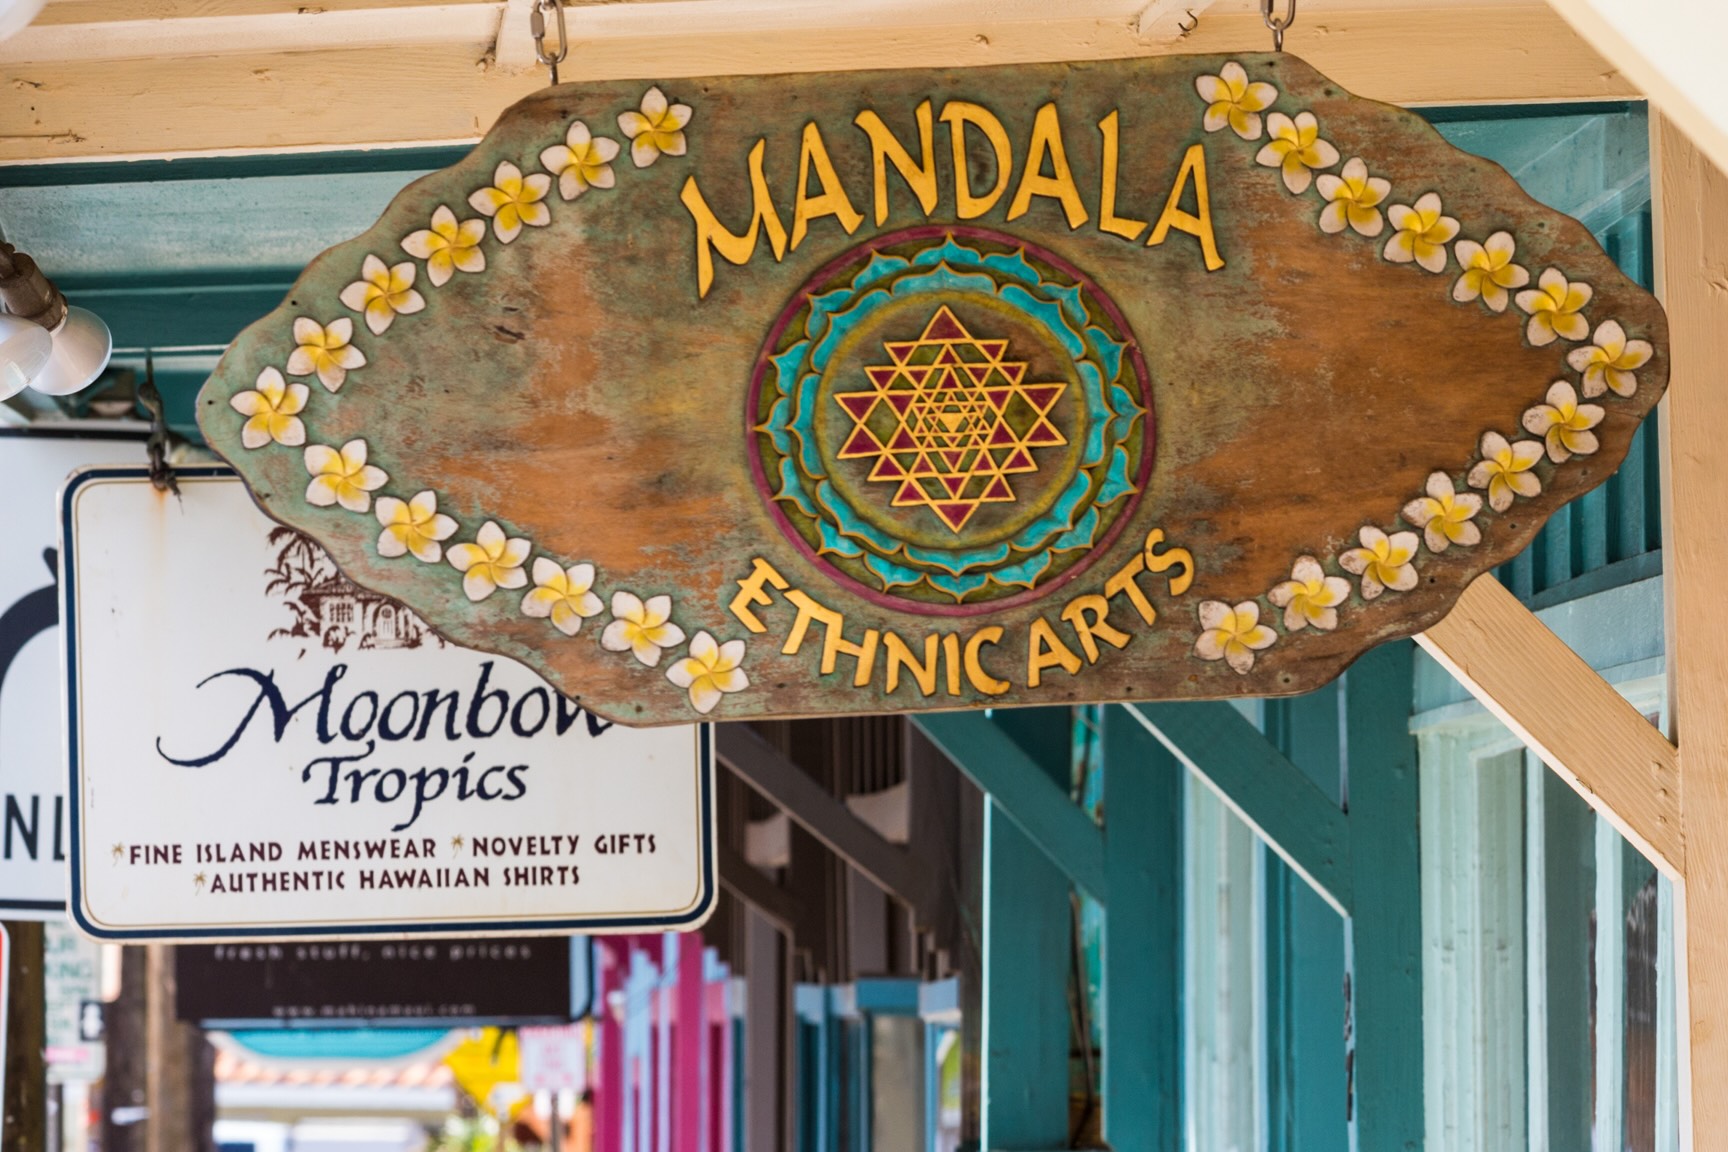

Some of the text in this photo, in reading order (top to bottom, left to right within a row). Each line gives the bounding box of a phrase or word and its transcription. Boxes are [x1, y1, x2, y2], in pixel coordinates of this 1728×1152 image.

[680, 101, 1225, 298] MANDALA
[727, 528, 1195, 697] ETHNIC ARTS
[156, 660, 615, 768] Moonbow
[302, 740, 530, 832] Tropics
[130, 834, 656, 865] FINE ISLAND MENSWEAR NOVELTY GIFTS
[210, 866, 580, 893] AUTHENTIC HAWAIIAN SHIRTS
[214, 945, 283, 961] fresh
[381, 944, 437, 960] nice
[449, 943, 532, 962] prices
